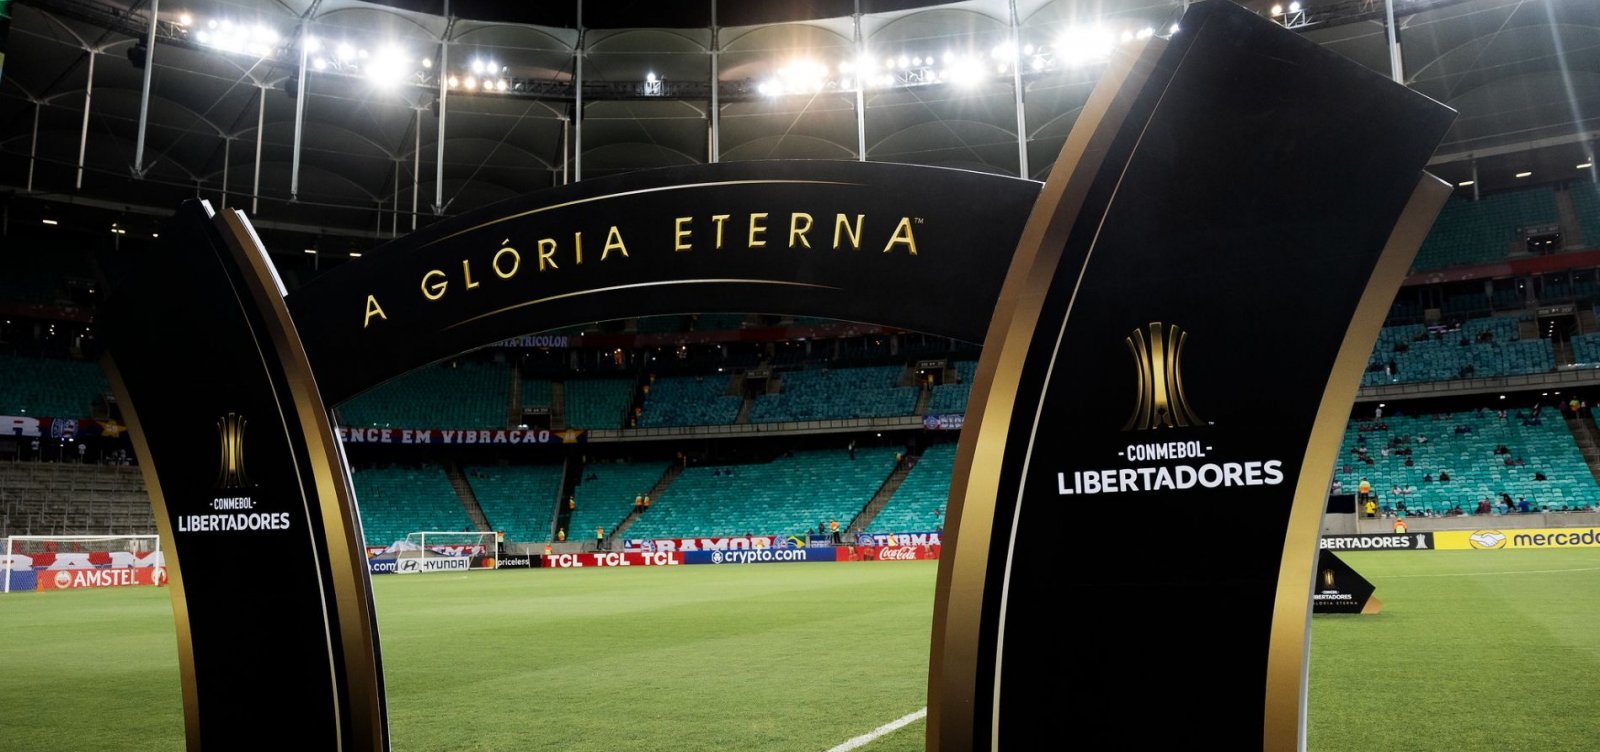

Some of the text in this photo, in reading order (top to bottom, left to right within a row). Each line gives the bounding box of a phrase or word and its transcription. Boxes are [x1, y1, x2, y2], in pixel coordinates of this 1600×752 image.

[364, 294, 387, 328] A
[420, 225, 629, 301] GLÓRIA
[518, 335, 569, 347] TRICOLOR
[401, 430, 431, 443] EM
[1057, 459, 1284, 495] LIBERTADORES
[177, 512, 290, 532] LIBERTADORES
[497, 557, 529, 568] priceless
[547, 554, 583, 567] TCL
[593, 553, 630, 566] TCL
[640, 551, 679, 565] TCL
[724, 548, 807, 564] crypto.com
[73, 568, 139, 588] AMSTEL
